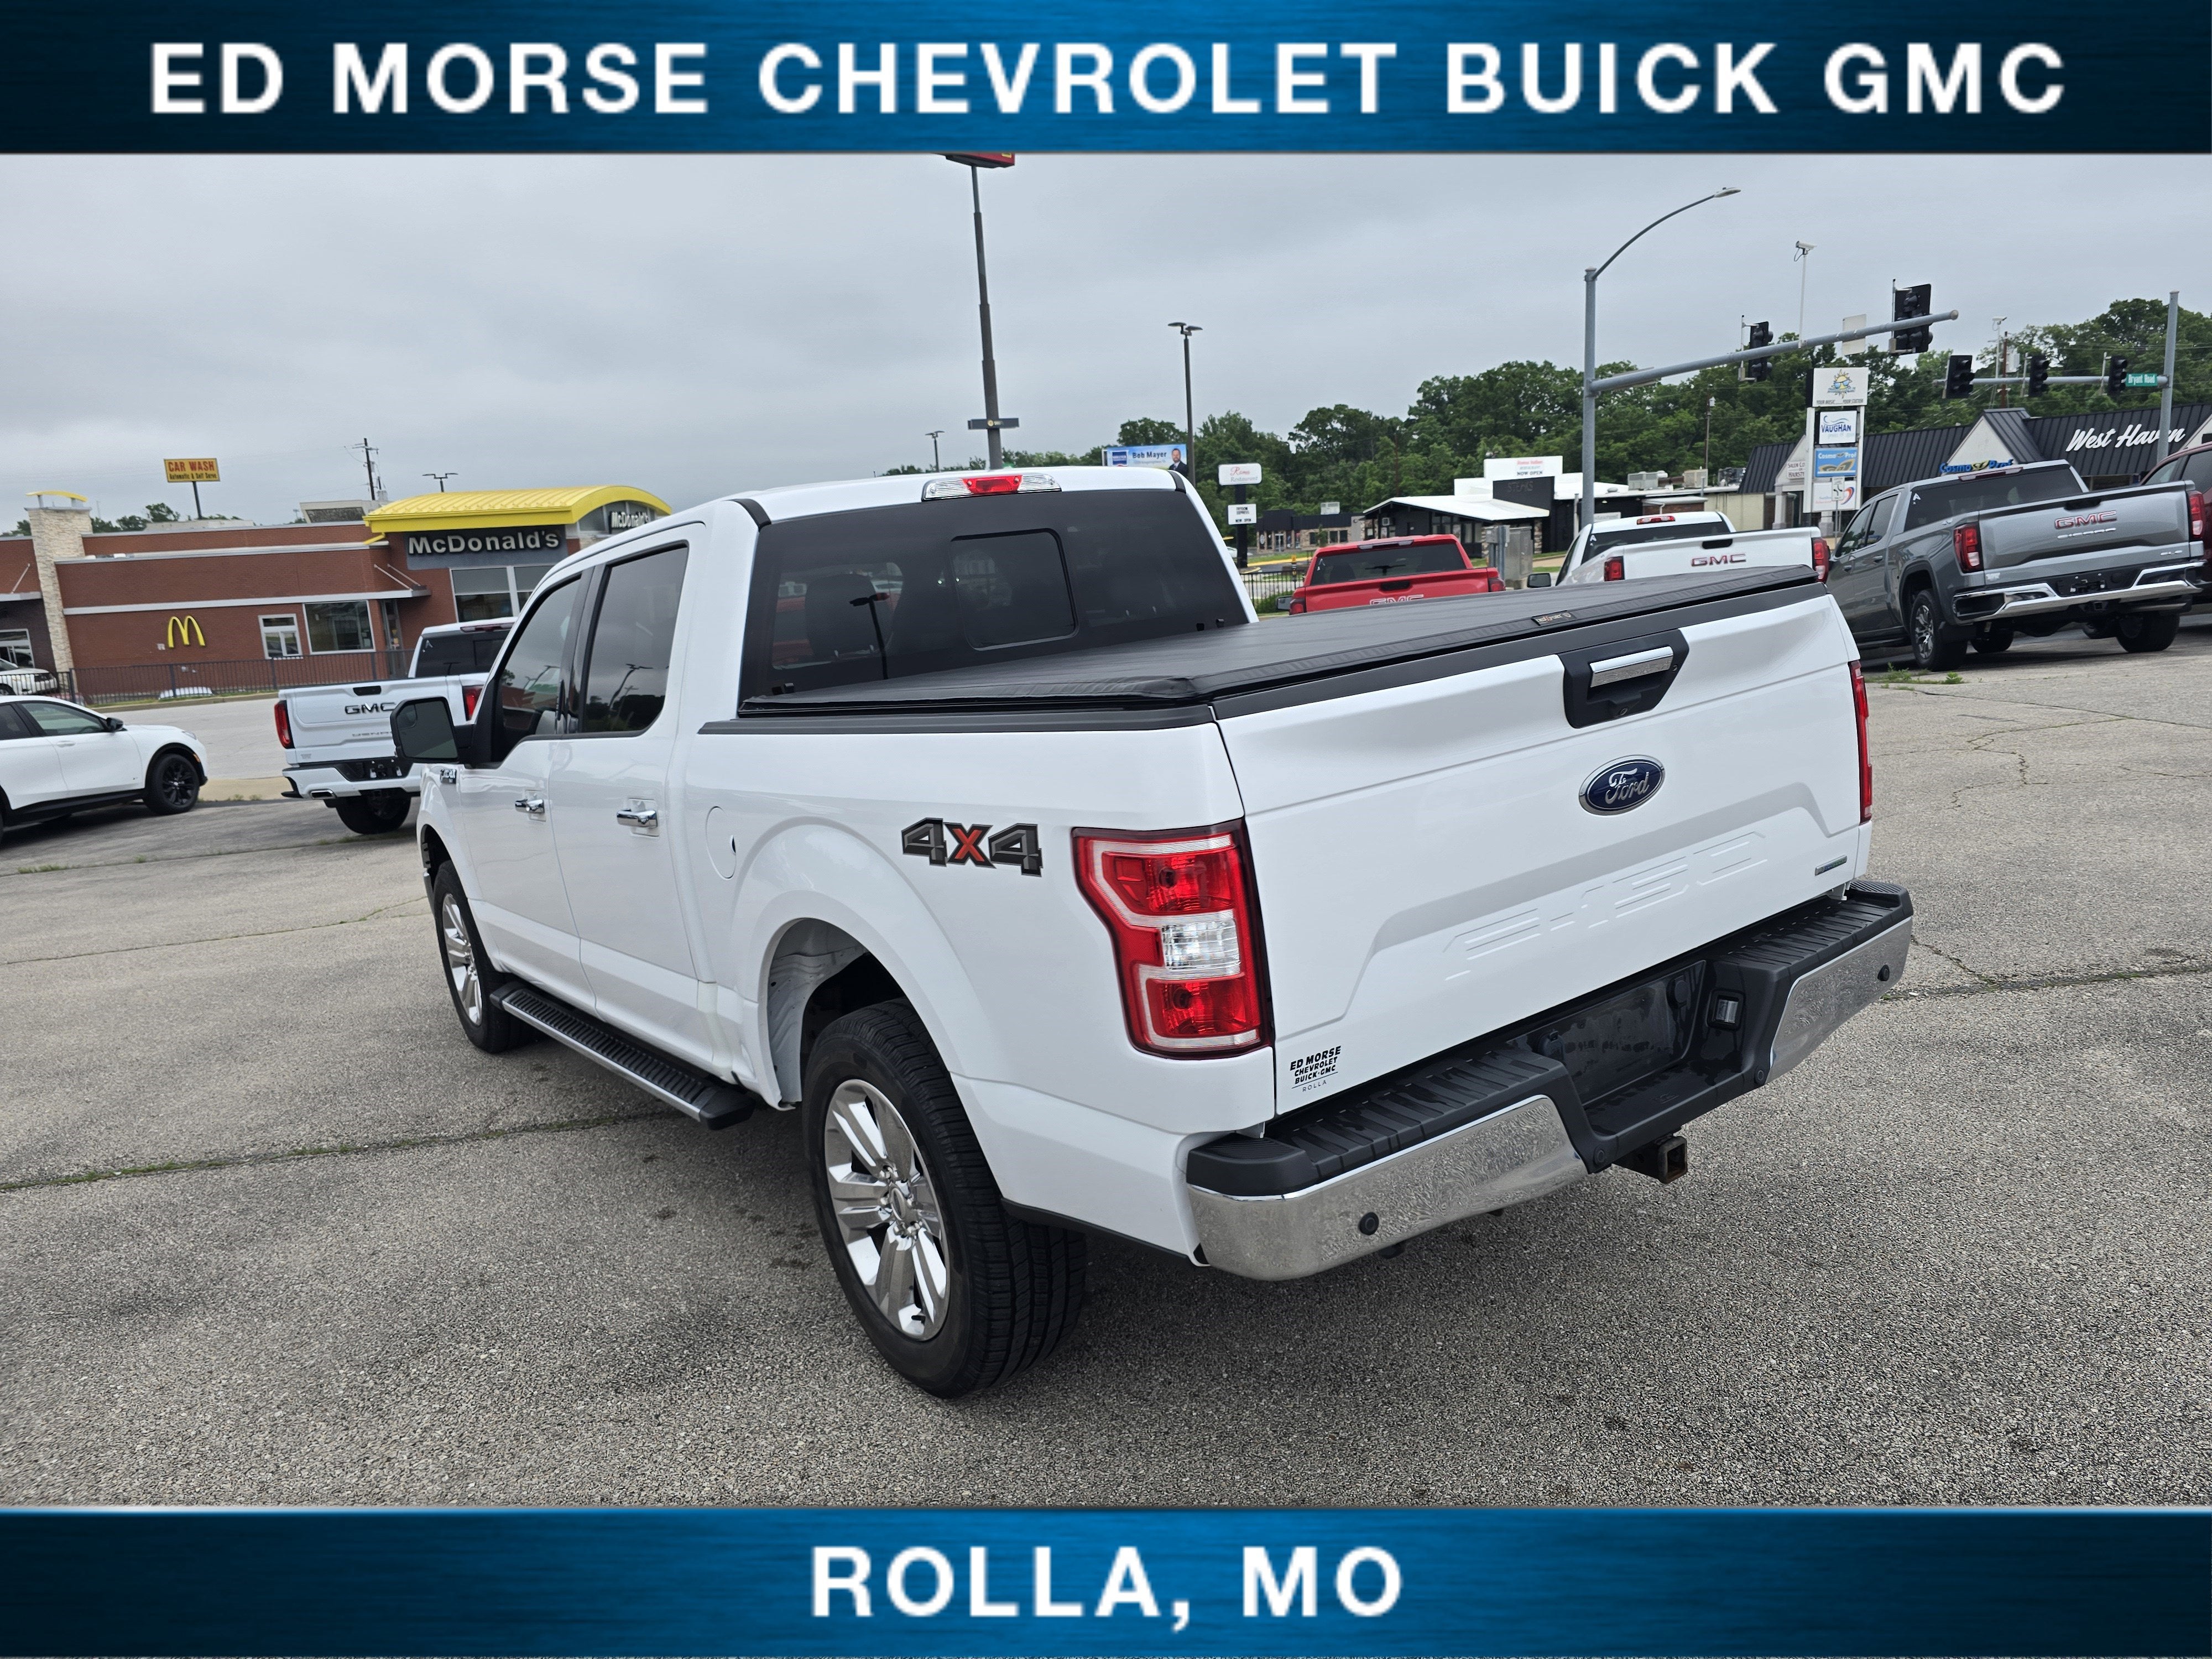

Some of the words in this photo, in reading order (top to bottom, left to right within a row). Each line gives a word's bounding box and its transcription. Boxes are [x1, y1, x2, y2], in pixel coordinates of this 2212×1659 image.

[1821, 424, 1851, 432] VAUGHAN
[2065, 427, 2116, 452] West
[2115, 424, 2186, 448] Havn
[1146, 451, 1167, 460] Mayer
[168, 461, 186, 472] CAR
[189, 461, 215, 472] WASH
[1939, 462, 1972, 473] Cosmo
[2054, 510, 2117, 530] GMC
[409, 531, 560, 554] McDonald's
[1691, 553, 1747, 567] GMC
[345, 702, 397, 714] GMC
[1605, 768, 1650, 805] Ford
[1290, 1058, 1303, 1071] ED
[1306, 1045, 1341, 1066] MORSE
[1295, 1056, 1338, 1077] CHEVROLET
[1302, 1079, 1327, 1092] ROLLA
